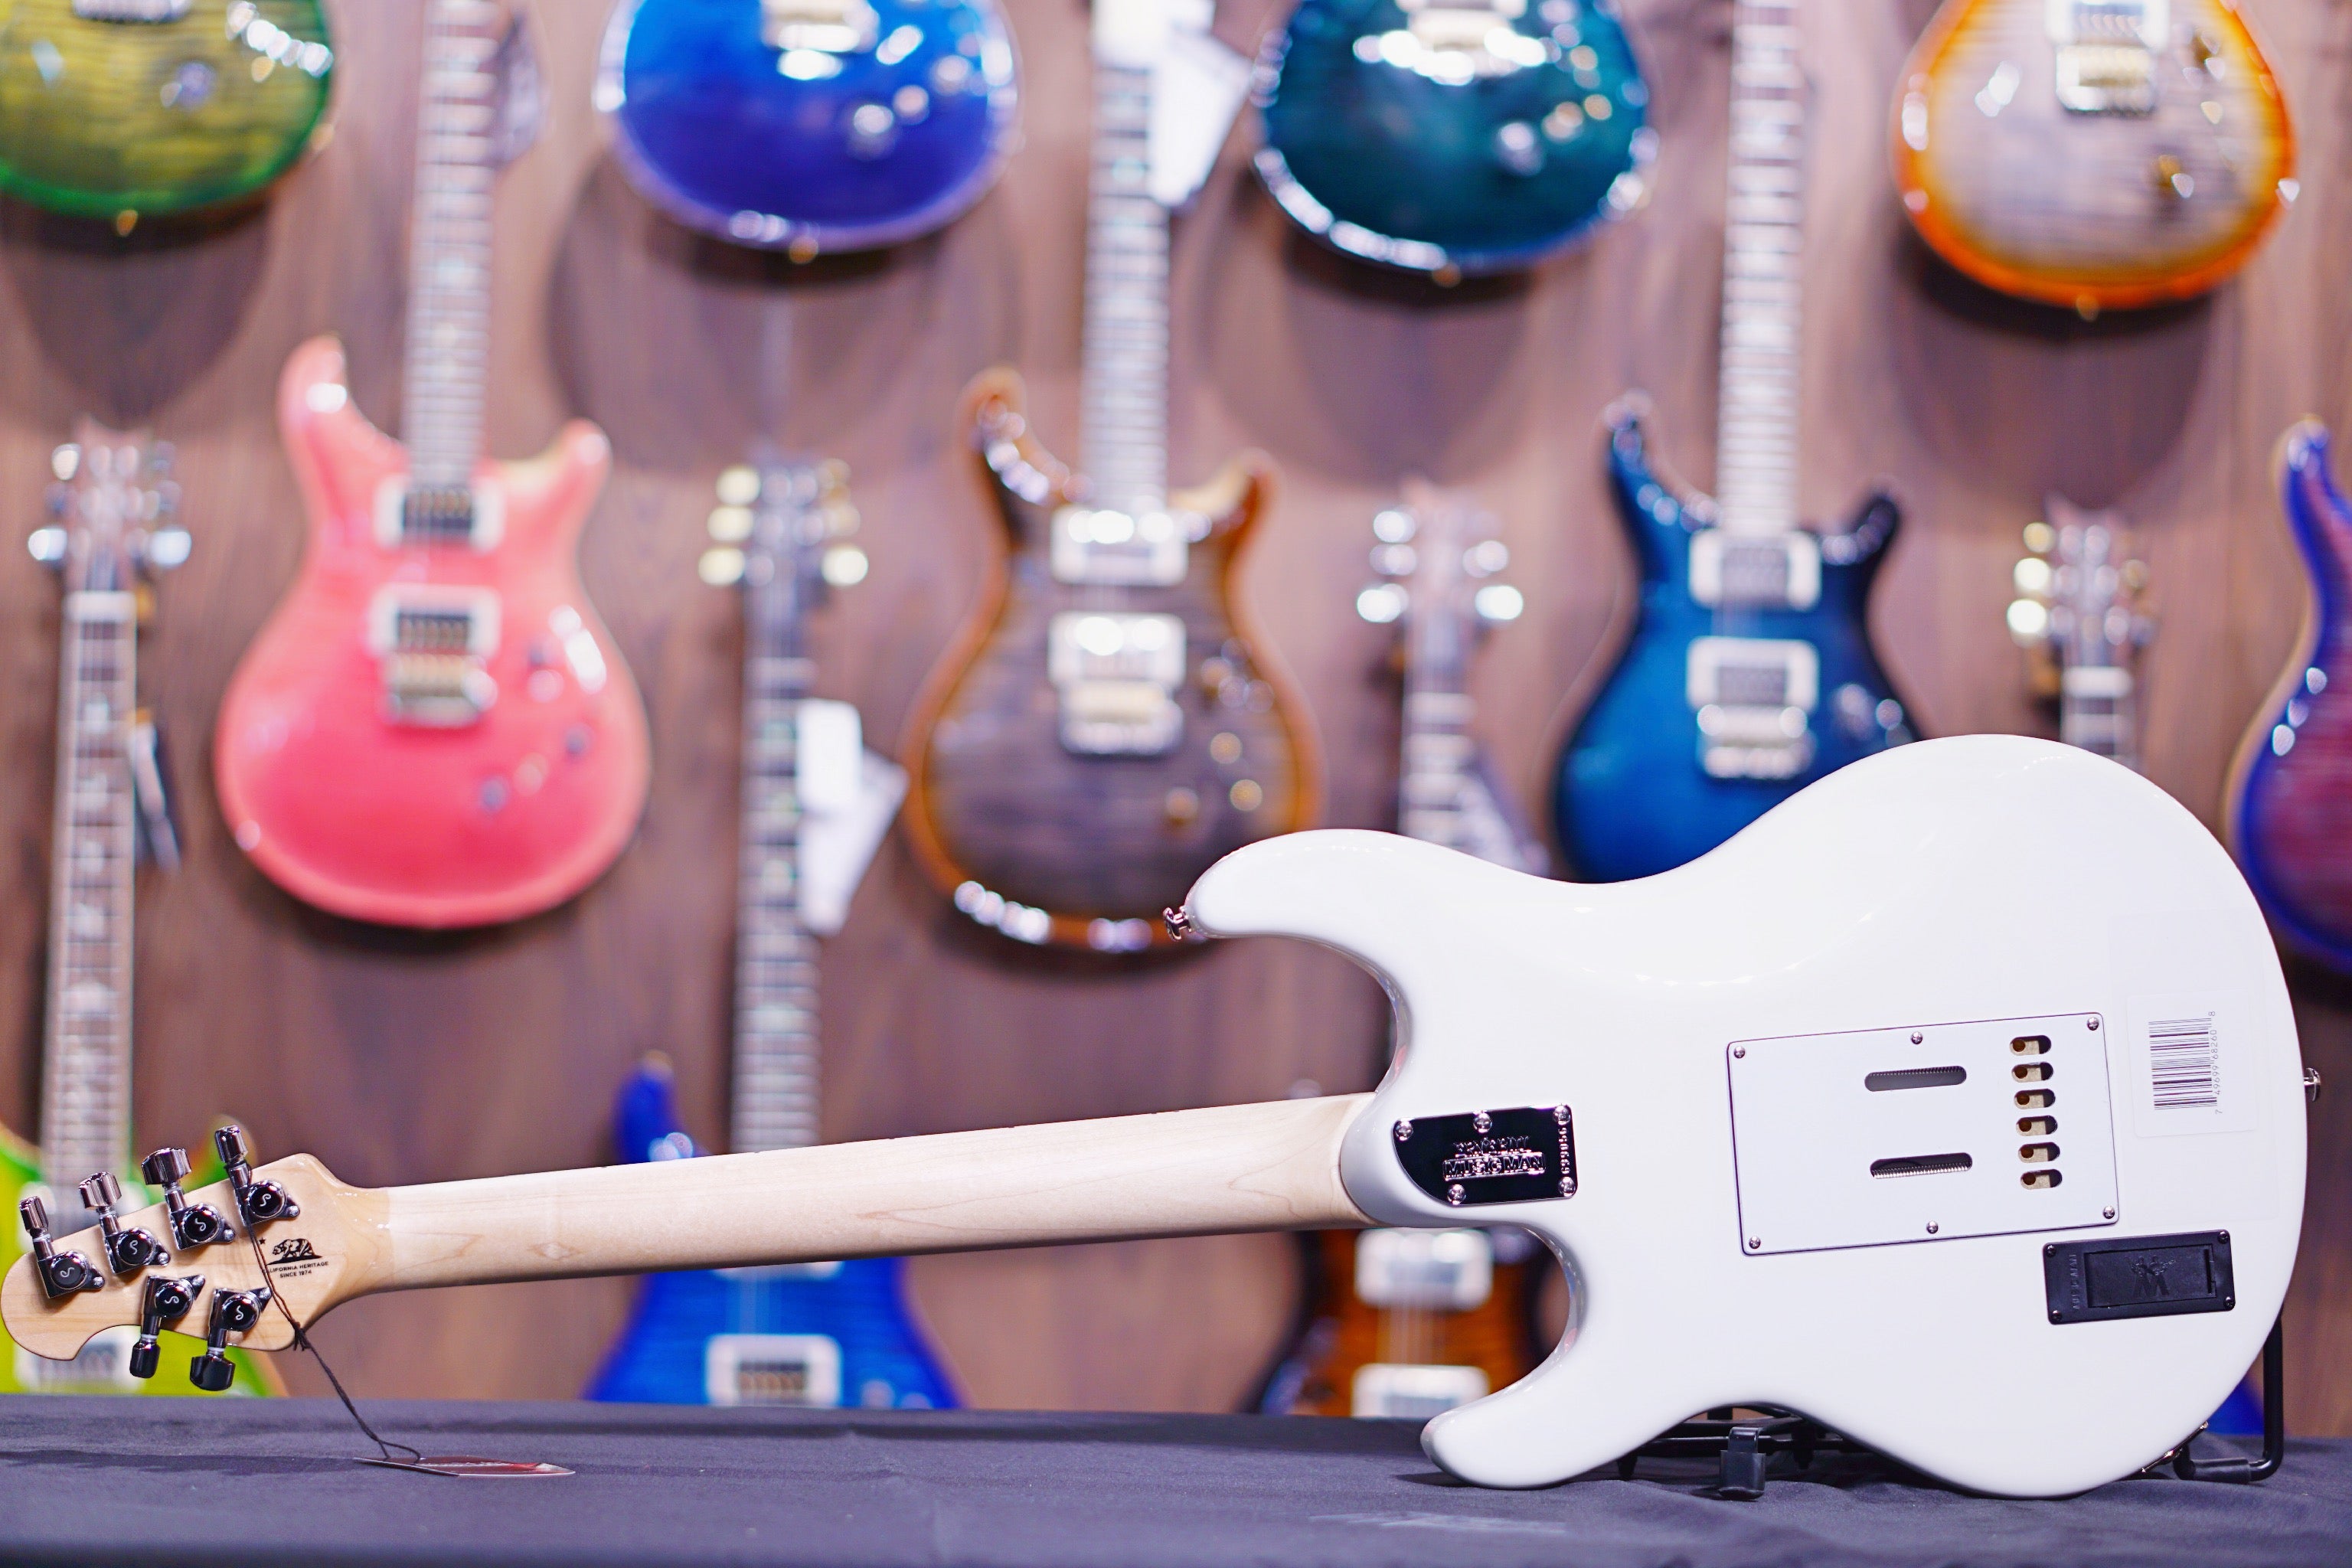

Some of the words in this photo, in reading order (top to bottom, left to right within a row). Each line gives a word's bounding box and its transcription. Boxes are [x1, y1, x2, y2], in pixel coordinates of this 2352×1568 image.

[2210, 1030, 2218, 1059] 68260
[1503, 1152, 1544, 1174] MAN
[269, 1265, 298, 1273] LIFORNIA
[299, 1260, 329, 1269] HERITAGE
